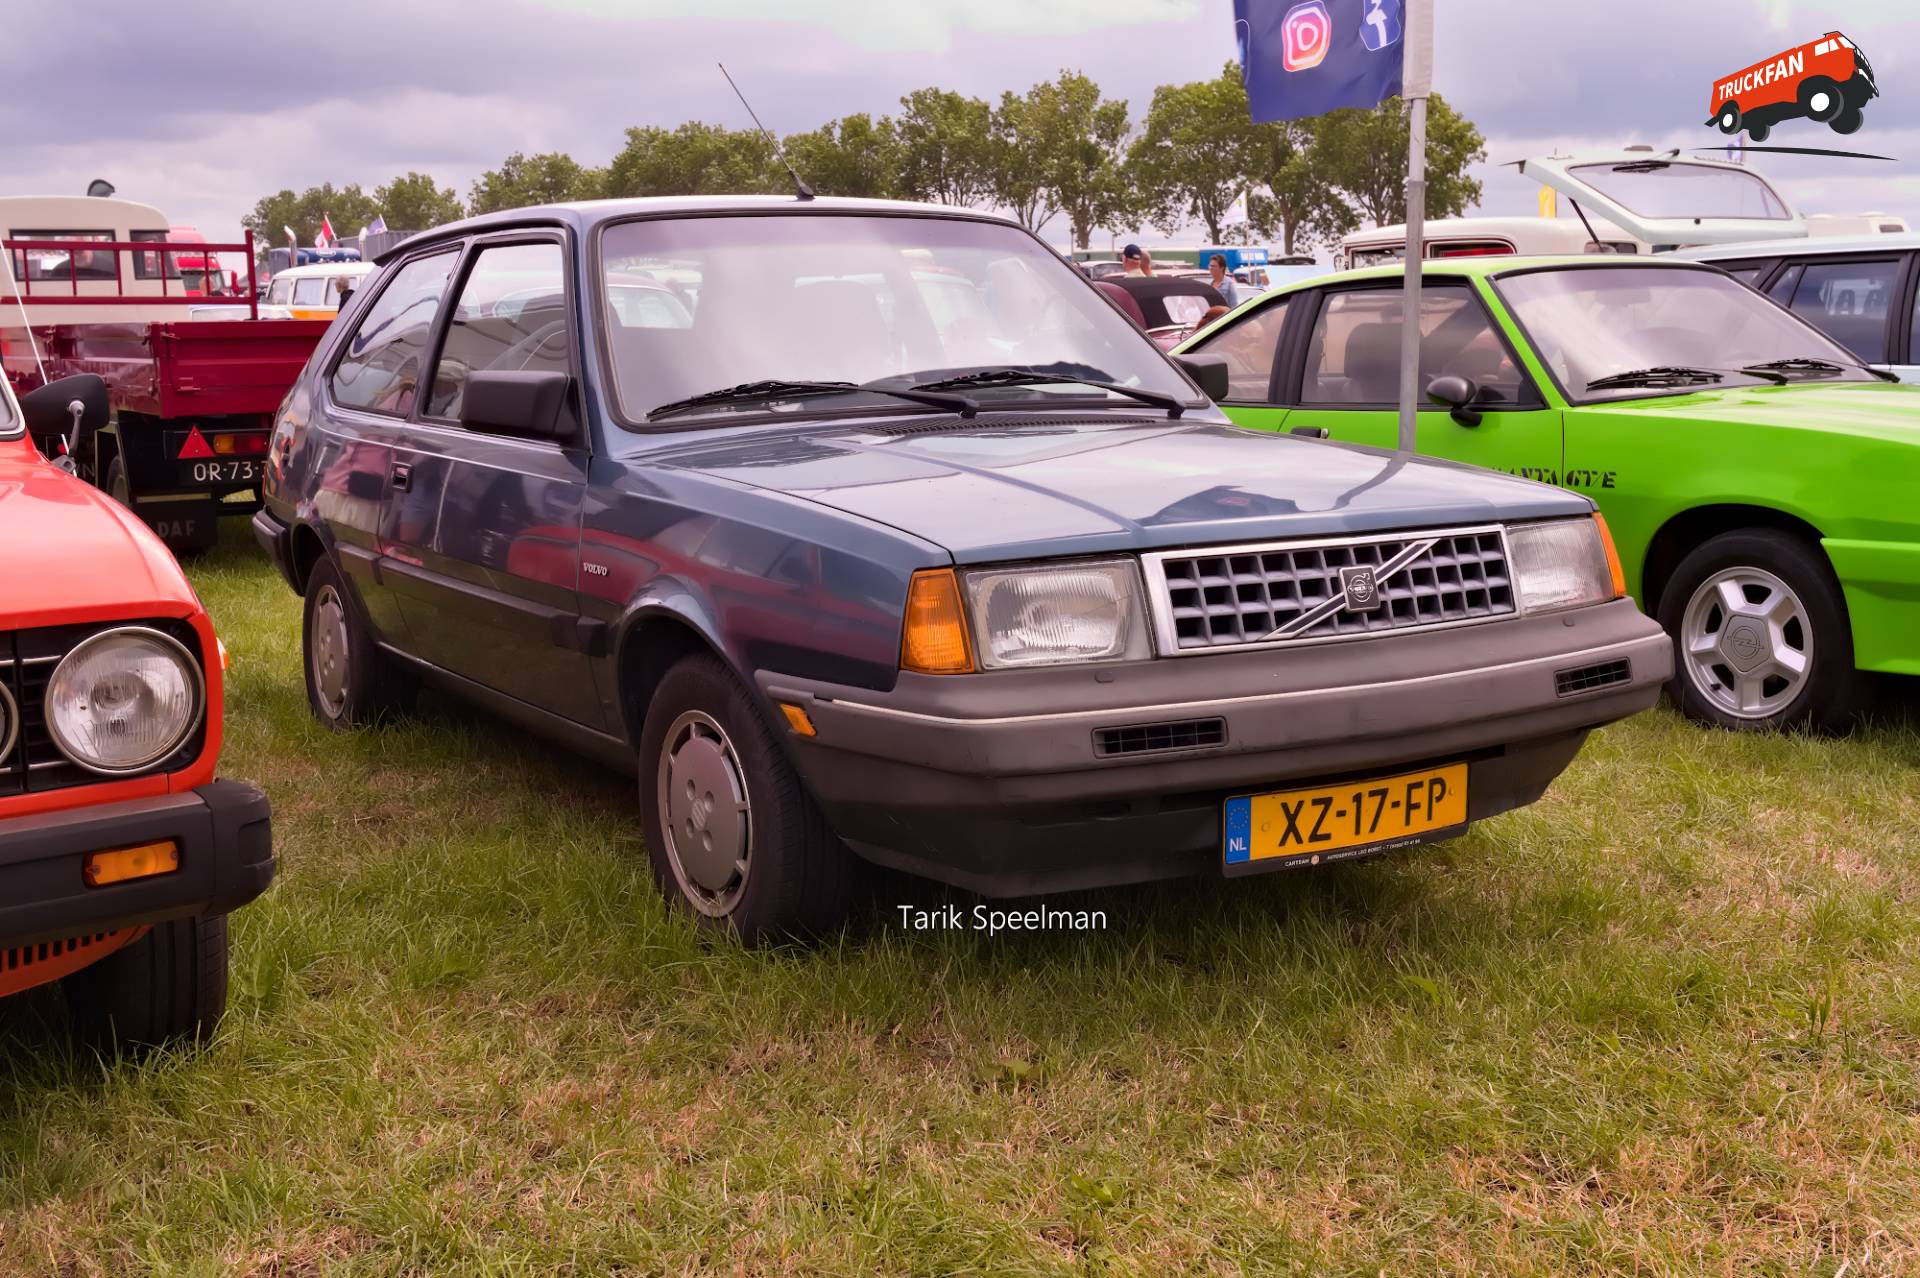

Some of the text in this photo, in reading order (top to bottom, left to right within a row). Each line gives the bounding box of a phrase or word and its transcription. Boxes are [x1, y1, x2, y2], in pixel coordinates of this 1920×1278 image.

[157, 520, 196, 537] DAF
[583, 562, 608, 576] VOLVO
[1277, 777, 1447, 848] XZ-17-FP
[1229, 837, 1247, 852] NL
